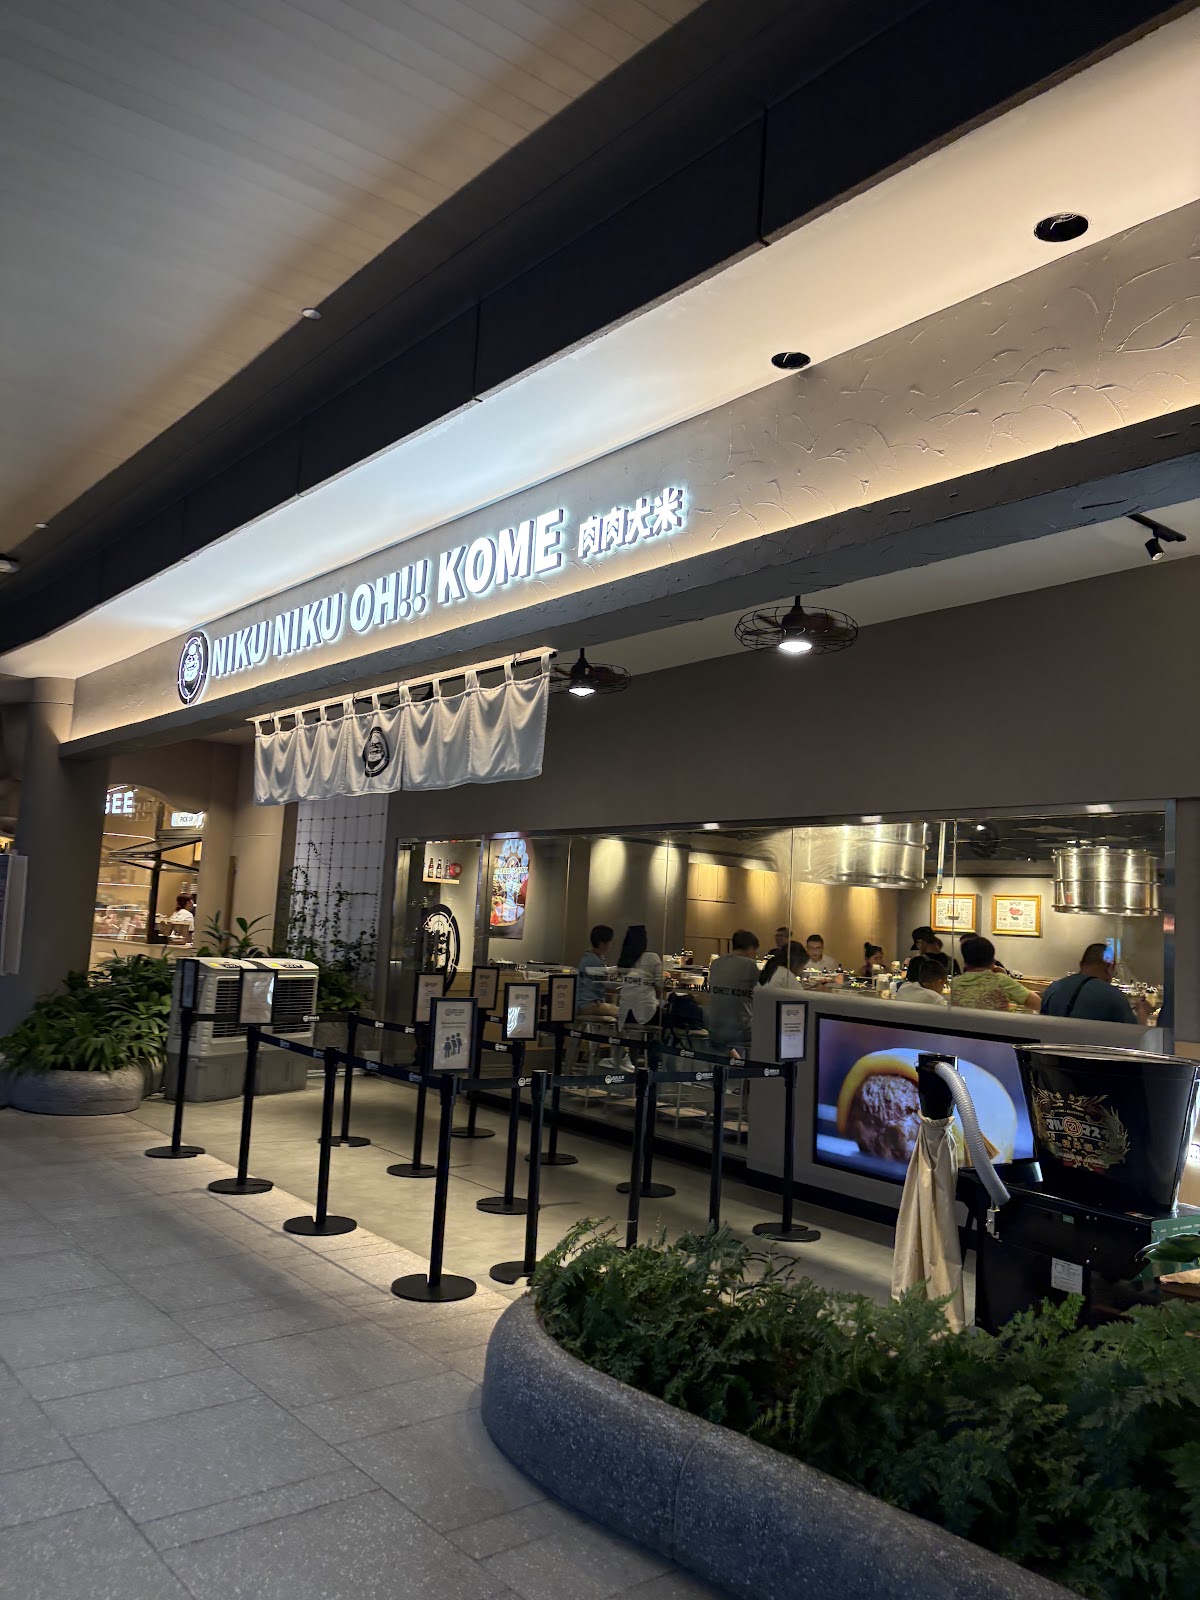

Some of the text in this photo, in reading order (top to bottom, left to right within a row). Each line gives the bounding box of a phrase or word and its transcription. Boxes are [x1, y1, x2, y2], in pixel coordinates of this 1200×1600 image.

[577, 487, 683, 559] 肉肉大米
[211, 508, 564, 677] NIKU NIKU OH!! KOME
